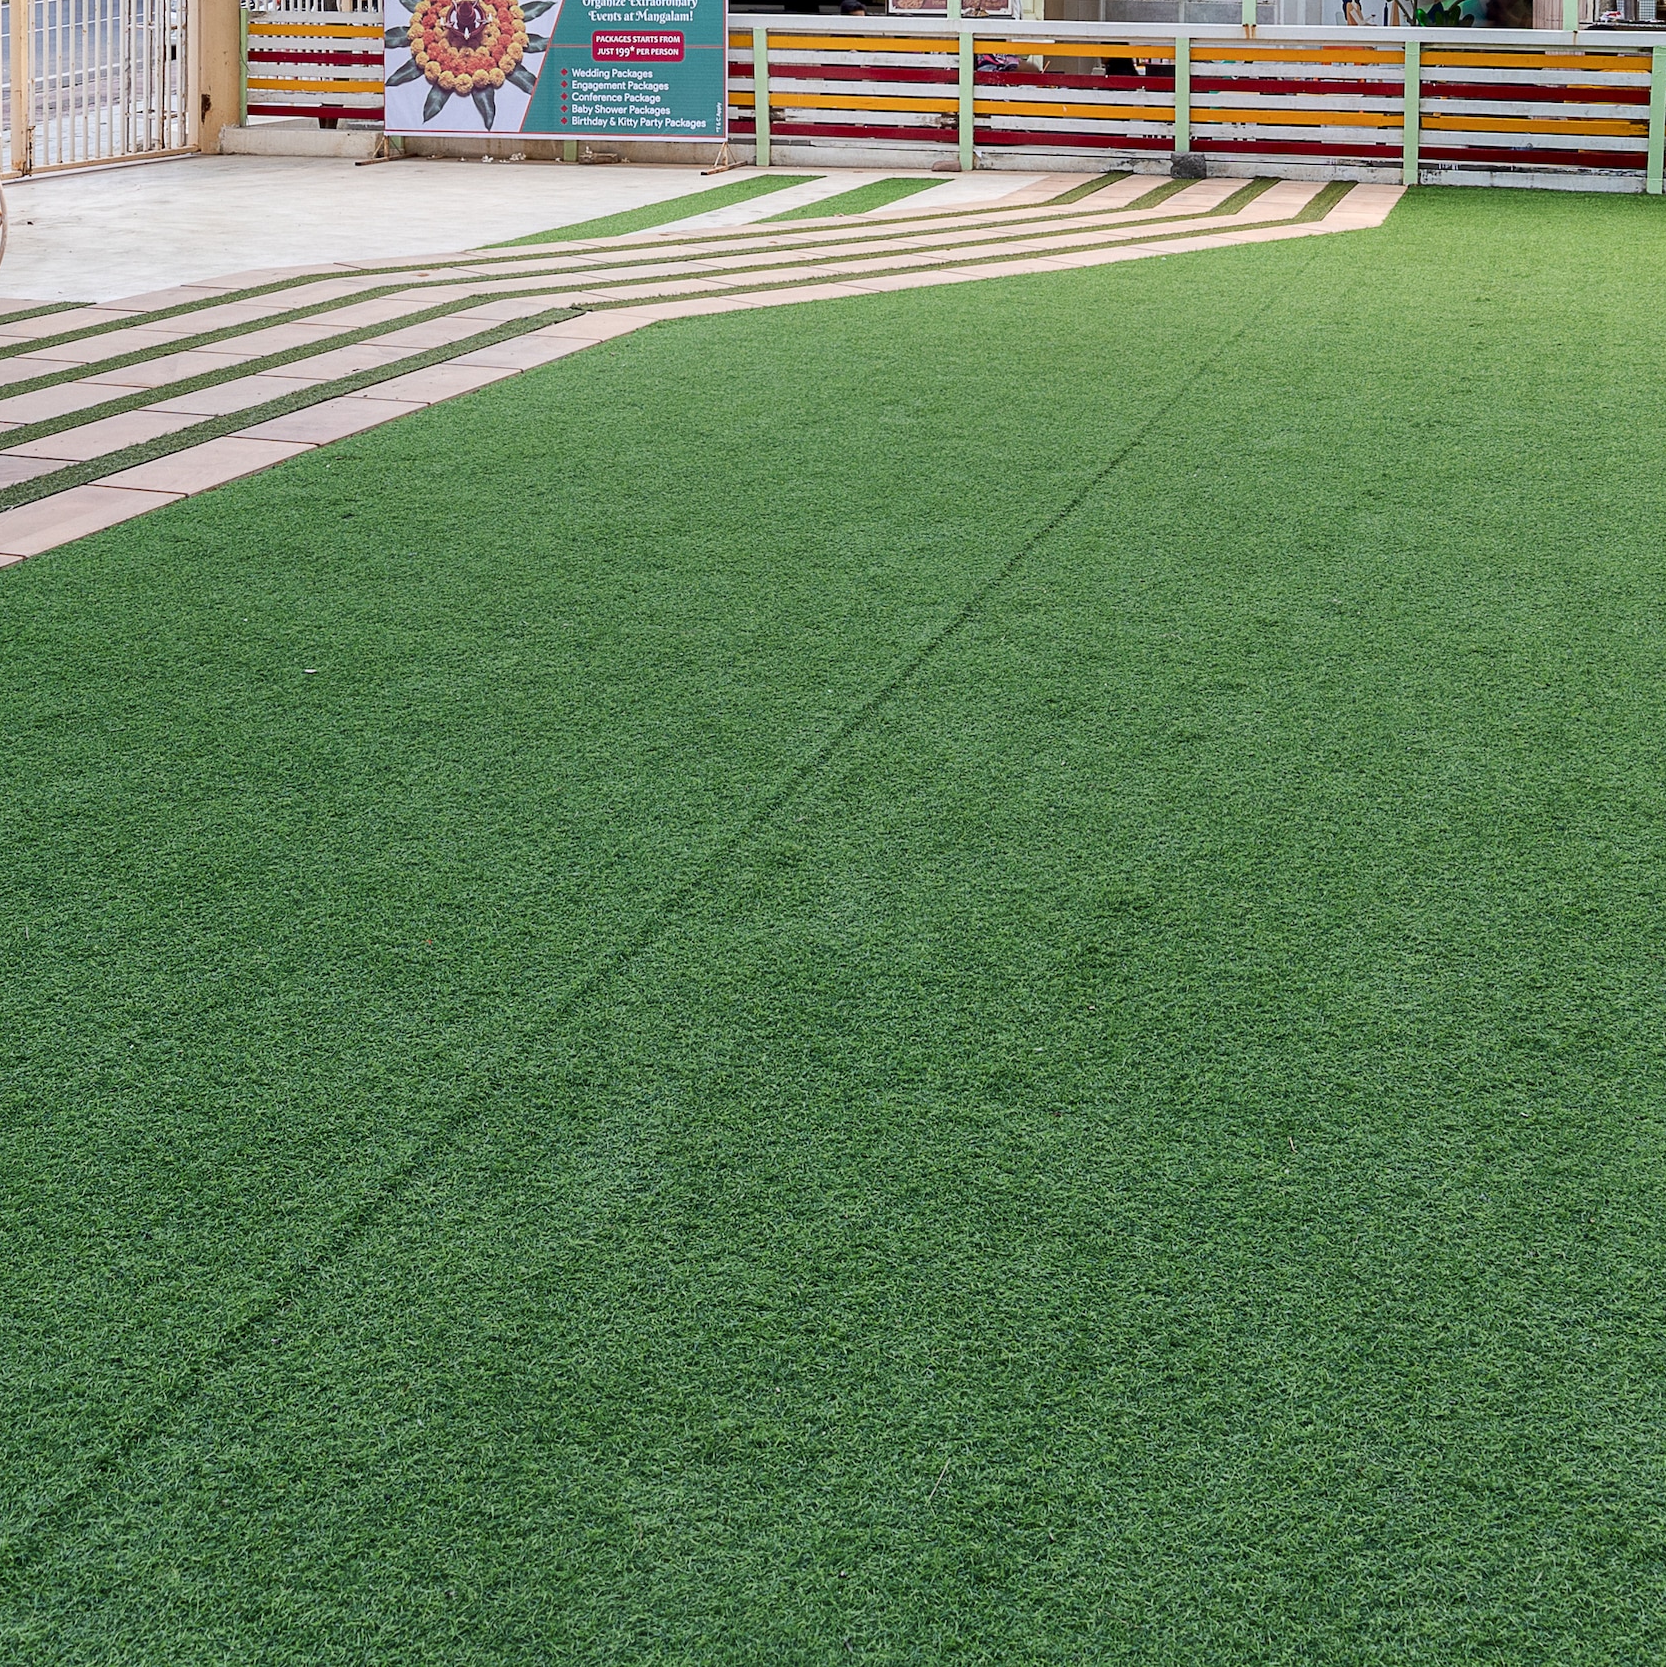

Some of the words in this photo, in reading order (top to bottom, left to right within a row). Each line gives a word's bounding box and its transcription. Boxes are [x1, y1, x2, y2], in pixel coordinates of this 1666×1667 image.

[588, 10, 622, 22] Events
[623, 12, 635, 22] at
[635, 9, 693, 24] Mangalam!
[595, 35, 632, 43] PACKAGES
[571, 68, 610, 80] Wedding
[611, 69, 653, 80] Packages
[571, 80, 626, 91] Engagement
[628, 81, 669, 92] Packages
[571, 92, 623, 102] Conference
[624, 93, 661, 104] Package
[571, 104, 593, 115] Baby
[594, 105, 627, 115] Shower
[629, 105, 670, 116] Packages
[571, 117, 608, 128] Birthday
[609, 118, 616, 126] &
[617, 118, 638, 129] Kitty
[639, 118, 662, 129] Party
[664, 118, 707, 129] Packages
